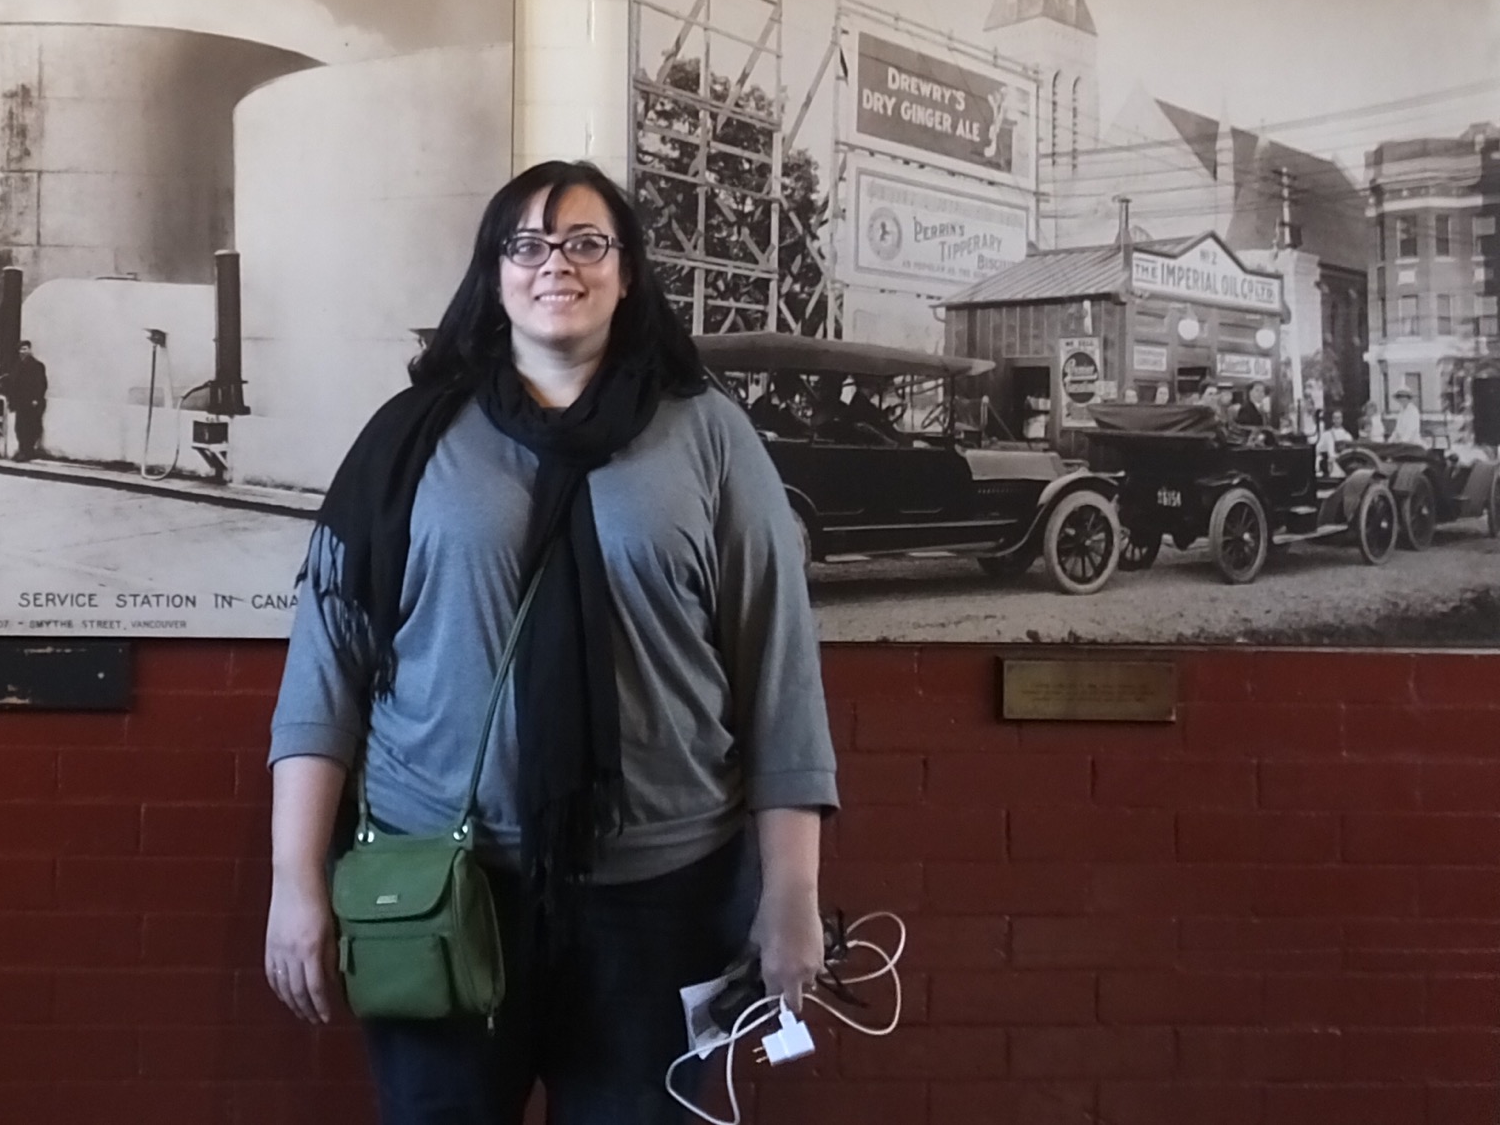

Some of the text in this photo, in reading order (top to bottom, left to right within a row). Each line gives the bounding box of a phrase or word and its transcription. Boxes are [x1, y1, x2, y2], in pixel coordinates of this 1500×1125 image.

[888, 67, 965, 110] DREWRY'S
[861, 88, 981, 143] DRY GINGER ALE
[912, 216, 966, 244] PERRIN'S
[938, 233, 1004, 263] TIPPERARY
[1134, 263, 1158, 279] THE
[1160, 261, 1219, 295] IMPERIAL
[1220, 274, 1239, 299] OIL
[18, 592, 99, 608] SERVICE
[115, 593, 197, 608] STATION
[213, 593, 233, 609] IN
[130, 620, 188, 630] VANCOUVER
